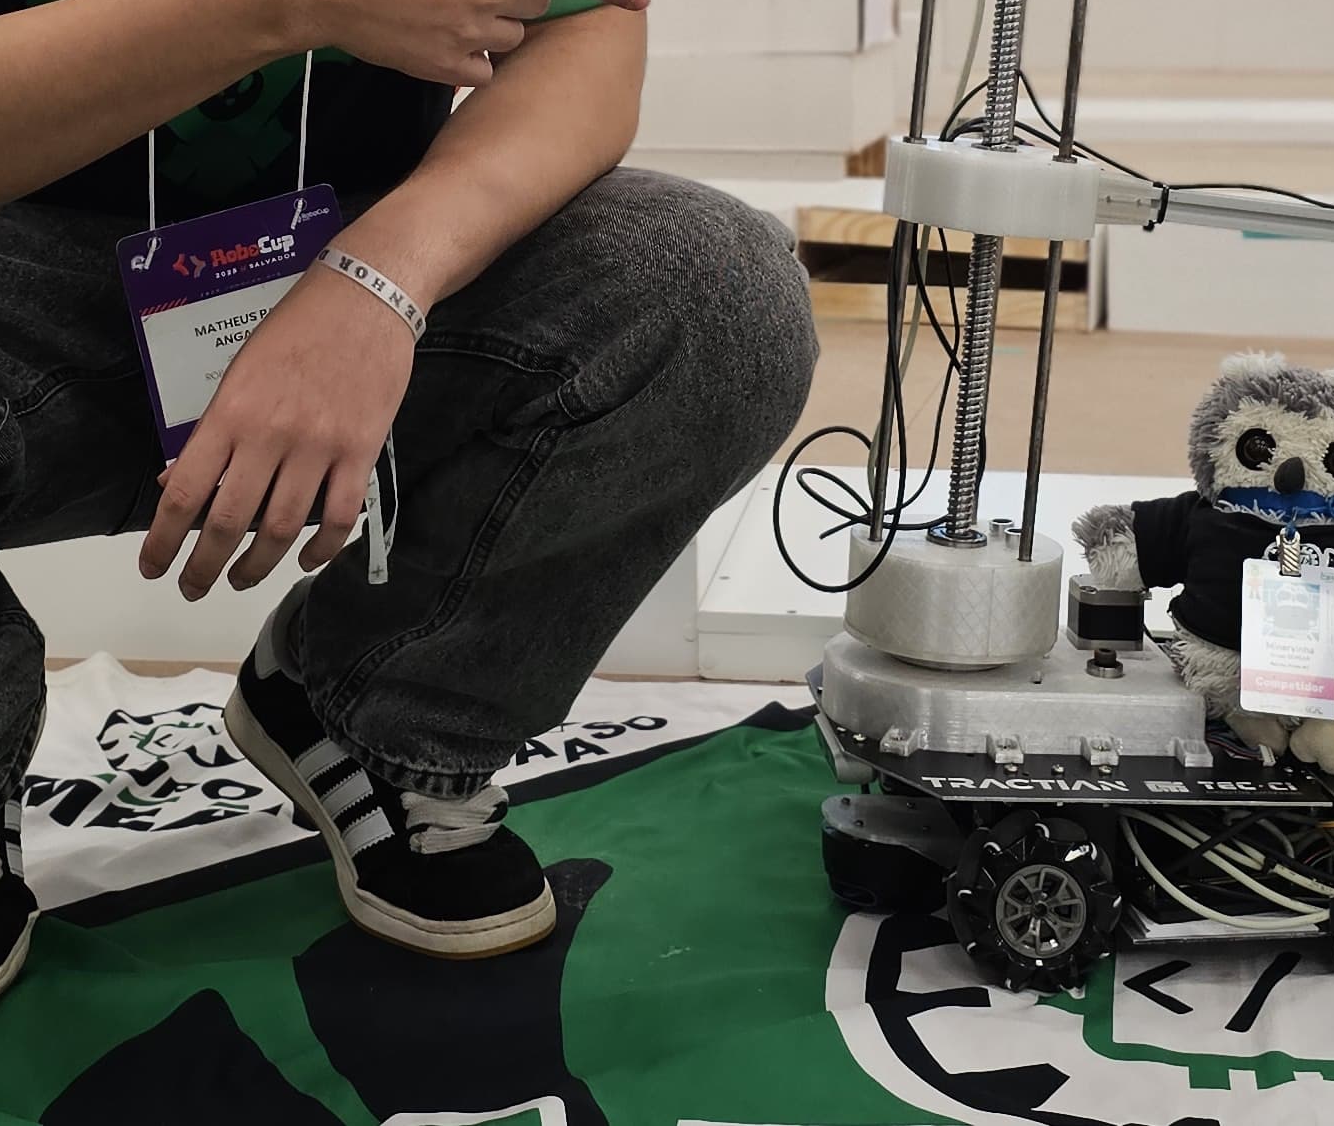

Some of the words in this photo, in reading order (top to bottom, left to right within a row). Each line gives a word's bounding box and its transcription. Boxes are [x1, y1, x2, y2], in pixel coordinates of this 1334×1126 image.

[210, 234, 296, 268] RoboCup
[248, 251, 297, 270] SALVADOR
[194, 311, 258, 337] MATHEUS
[1255, 676, 1326, 694] Competidor
[921, 776, 1130, 792] TRACTIAN
